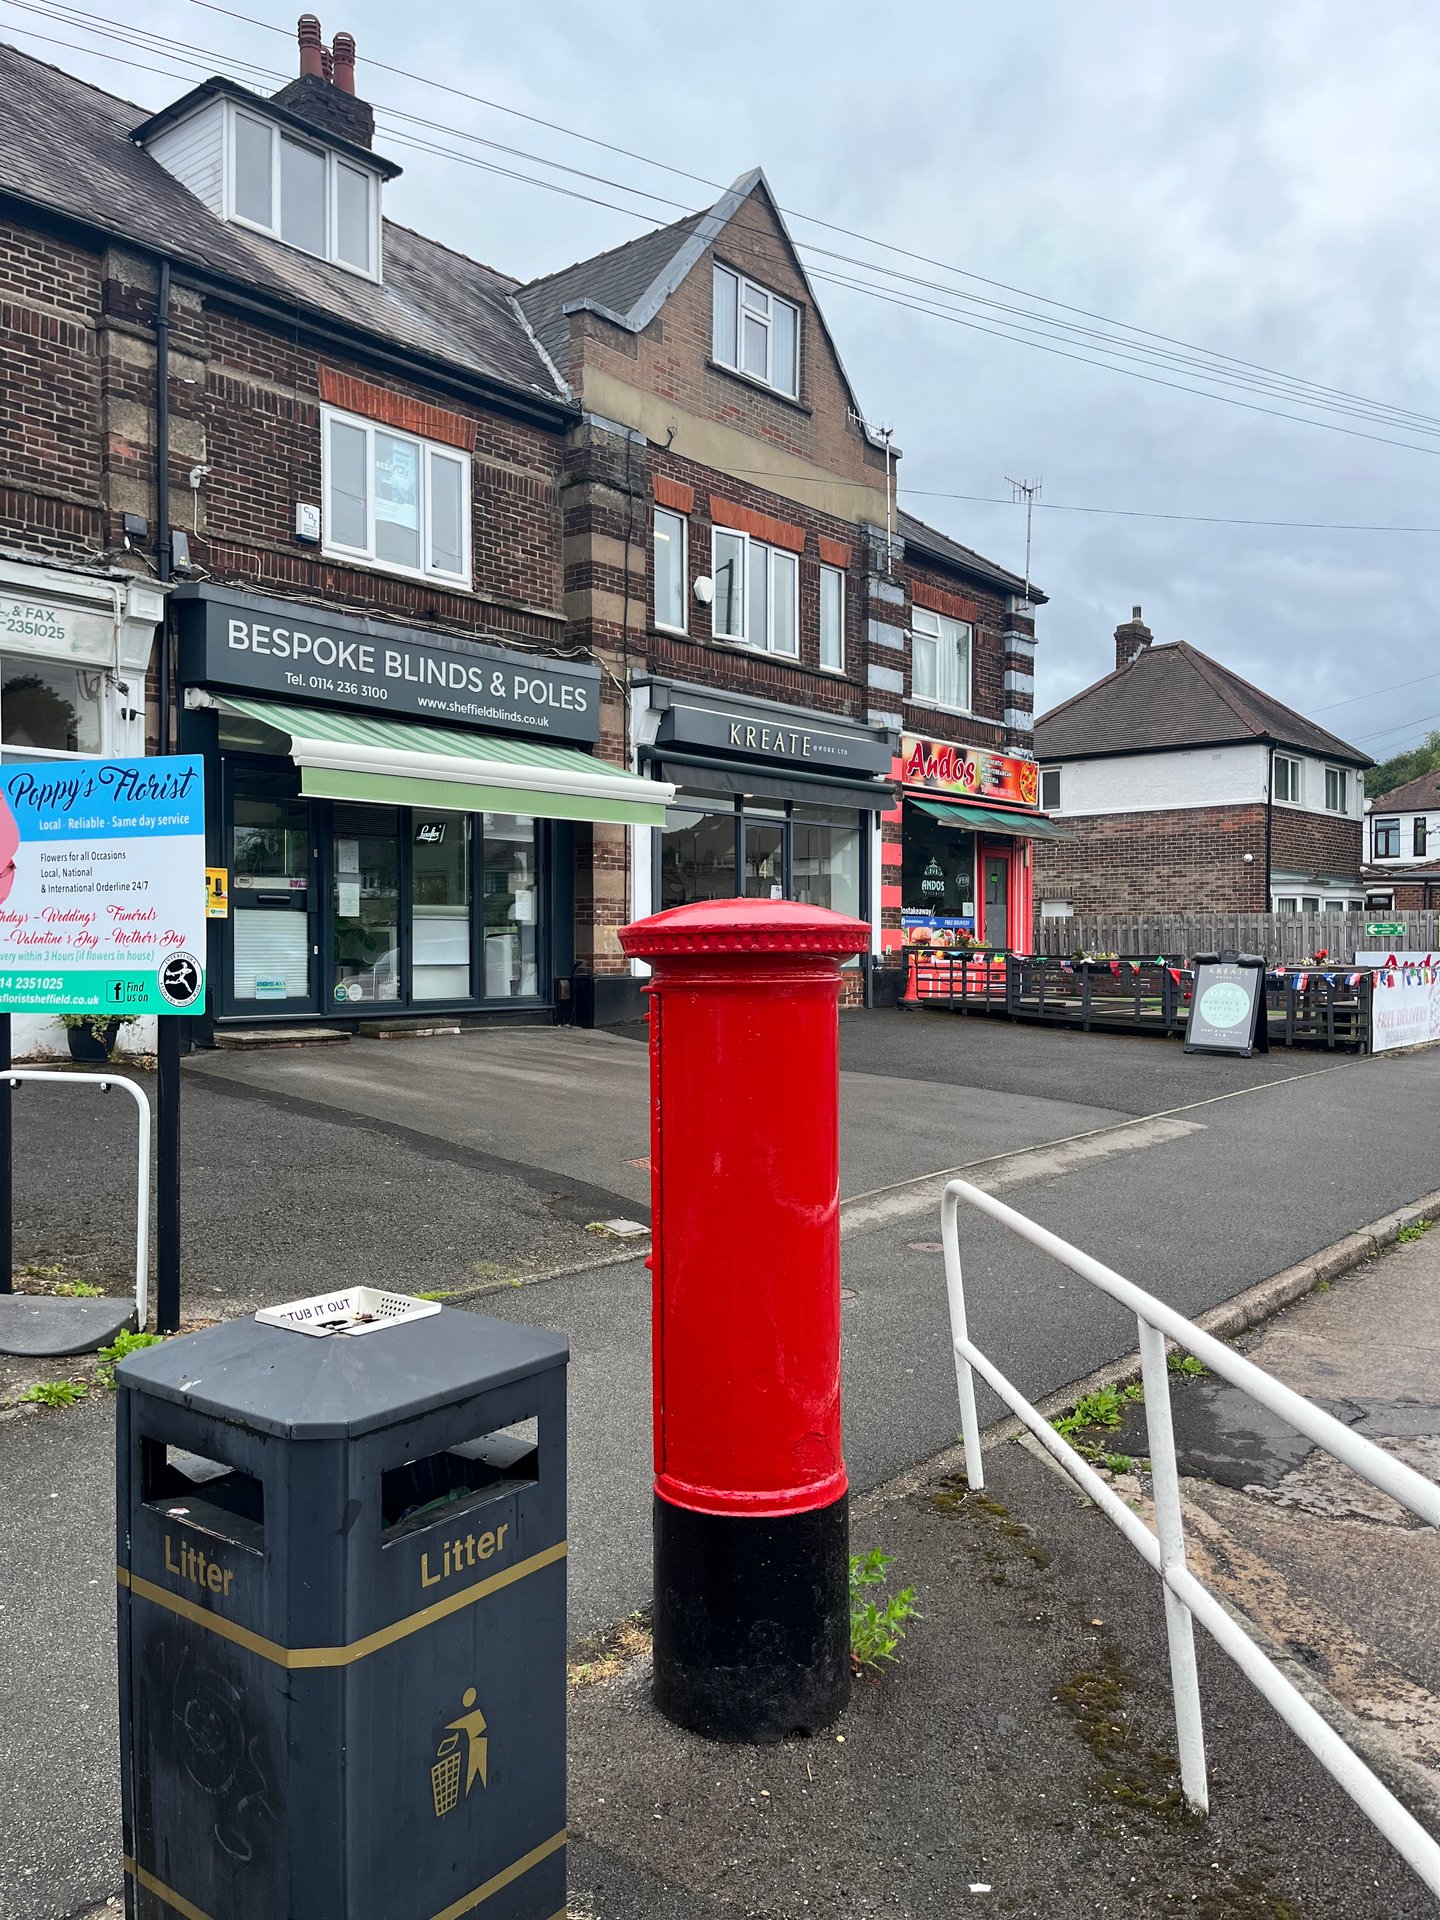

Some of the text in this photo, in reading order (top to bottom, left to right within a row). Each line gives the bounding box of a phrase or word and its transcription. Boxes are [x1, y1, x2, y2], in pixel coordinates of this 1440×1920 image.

[12, 605, 21, 617] &
[228, 618, 588, 712] BESPOKE BLINDS & POLES
[284, 671, 388, 700] Tel. 0114 236 3100
[417, 697, 550, 728] www.sheffieldblinds.co.uk
[730, 722, 811, 757] KREATE
[906, 741, 976, 787] Andos
[8, 765, 199, 812] Poppy's Florist
[40, 818, 60, 830] Local
[68, 817, 105, 829] Reliable
[112, 815, 137, 828] Same
[139, 814, 155, 829] day
[157, 813, 190, 826] service
[40, 851, 126, 862] Flowers for all Occasions
[40, 867, 93, 879] Local, National
[758, 859, 768, 879] 4
[41, 881, 149, 893] & International Orderline 24/7
[921, 879, 945, 891] ANDOS
[41, 906, 97, 928] Weddings
[106, 904, 157, 921] Funerals
[10, 929, 71, 945] Valentine's
[73, 930, 98, 949] Day
[159, 929, 186, 949] Day
[18, 950, 42, 961] within
[44, 950, 50, 961] 3
[51, 950, 74, 961] Hours
[75, 949, 85, 962] (if
[86, 949, 115, 961] flowers
[117, 949, 125, 960] in
[126, 949, 155, 962] house)
[15, 977, 63, 989] 2351025
[127, 981, 145, 992] Find
[1376, 1009, 1396, 1029] FREE
[314, 1305, 324, 1316] IT
[327, 1299, 351, 1313] OUT
[422, 1522, 509, 1588] Litter
[163, 1535, 234, 1597] Litter
